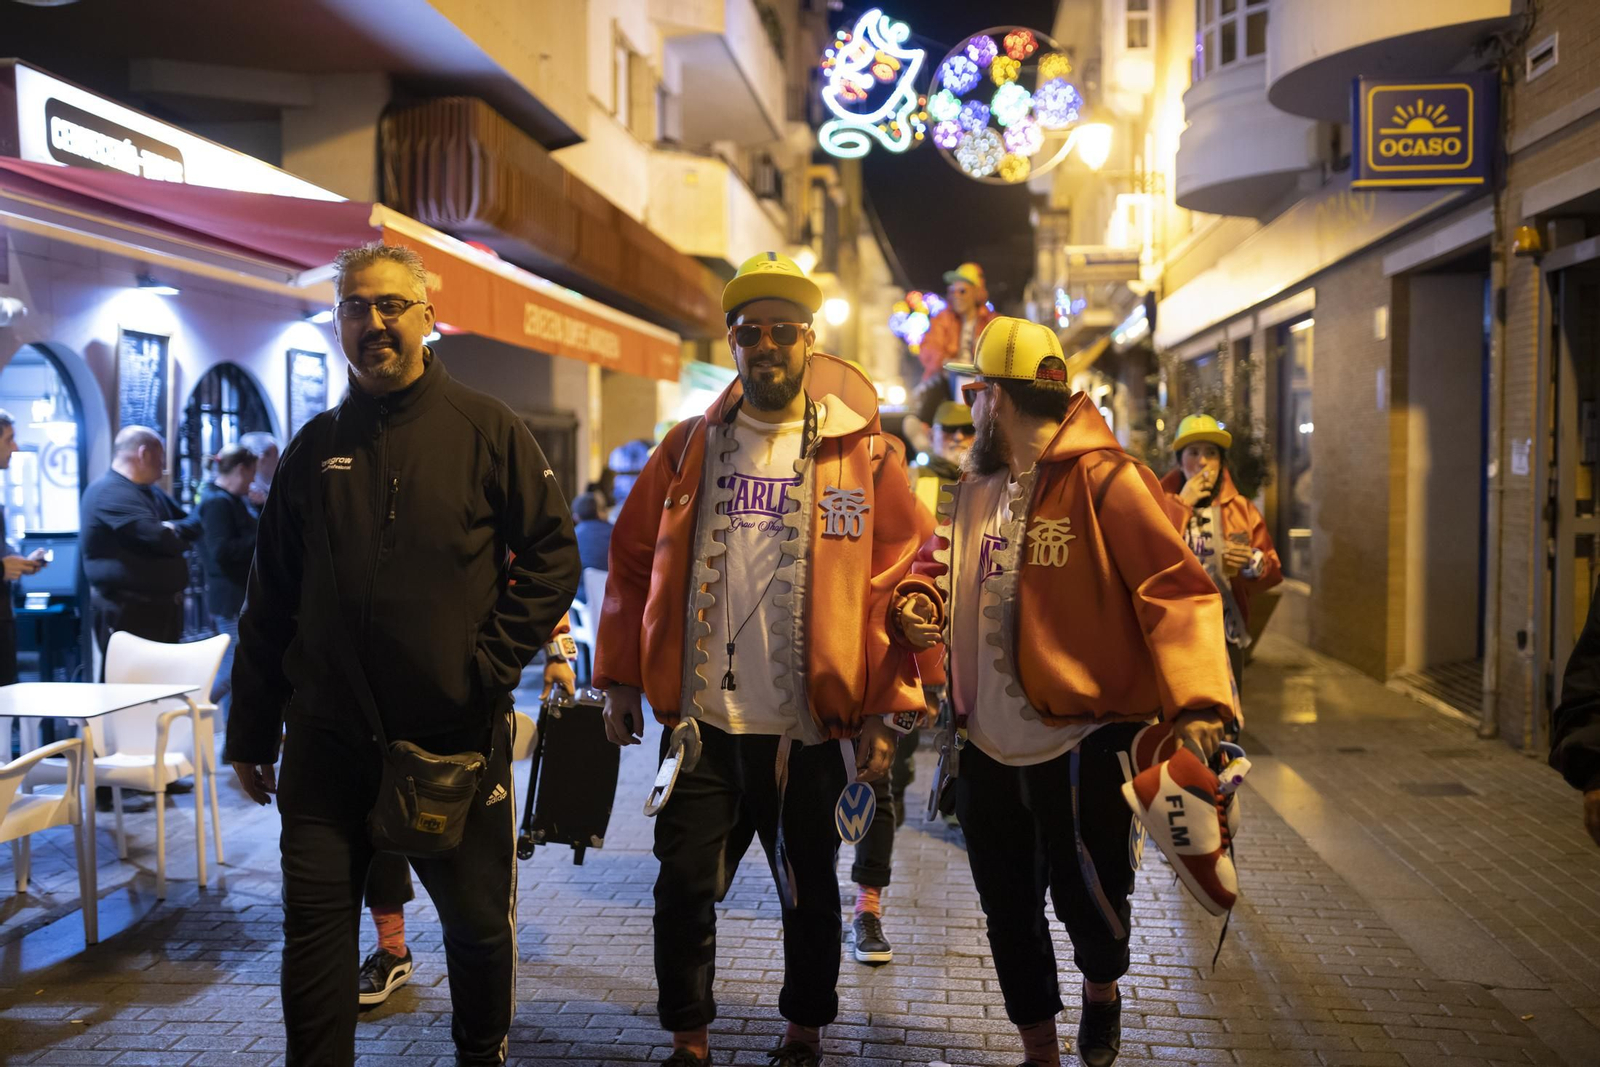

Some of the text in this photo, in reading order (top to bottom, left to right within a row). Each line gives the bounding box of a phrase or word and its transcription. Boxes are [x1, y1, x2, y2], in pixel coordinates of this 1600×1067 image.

[1379, 137, 1462, 157] OCASO
[726, 476, 800, 515] ARLE
[727, 516, 784, 538] Grow Shop
[822, 511, 864, 537] 100
[1028, 542, 1069, 568] 100
[838, 784, 875, 840] VW
[1165, 795, 1191, 847] FLM
